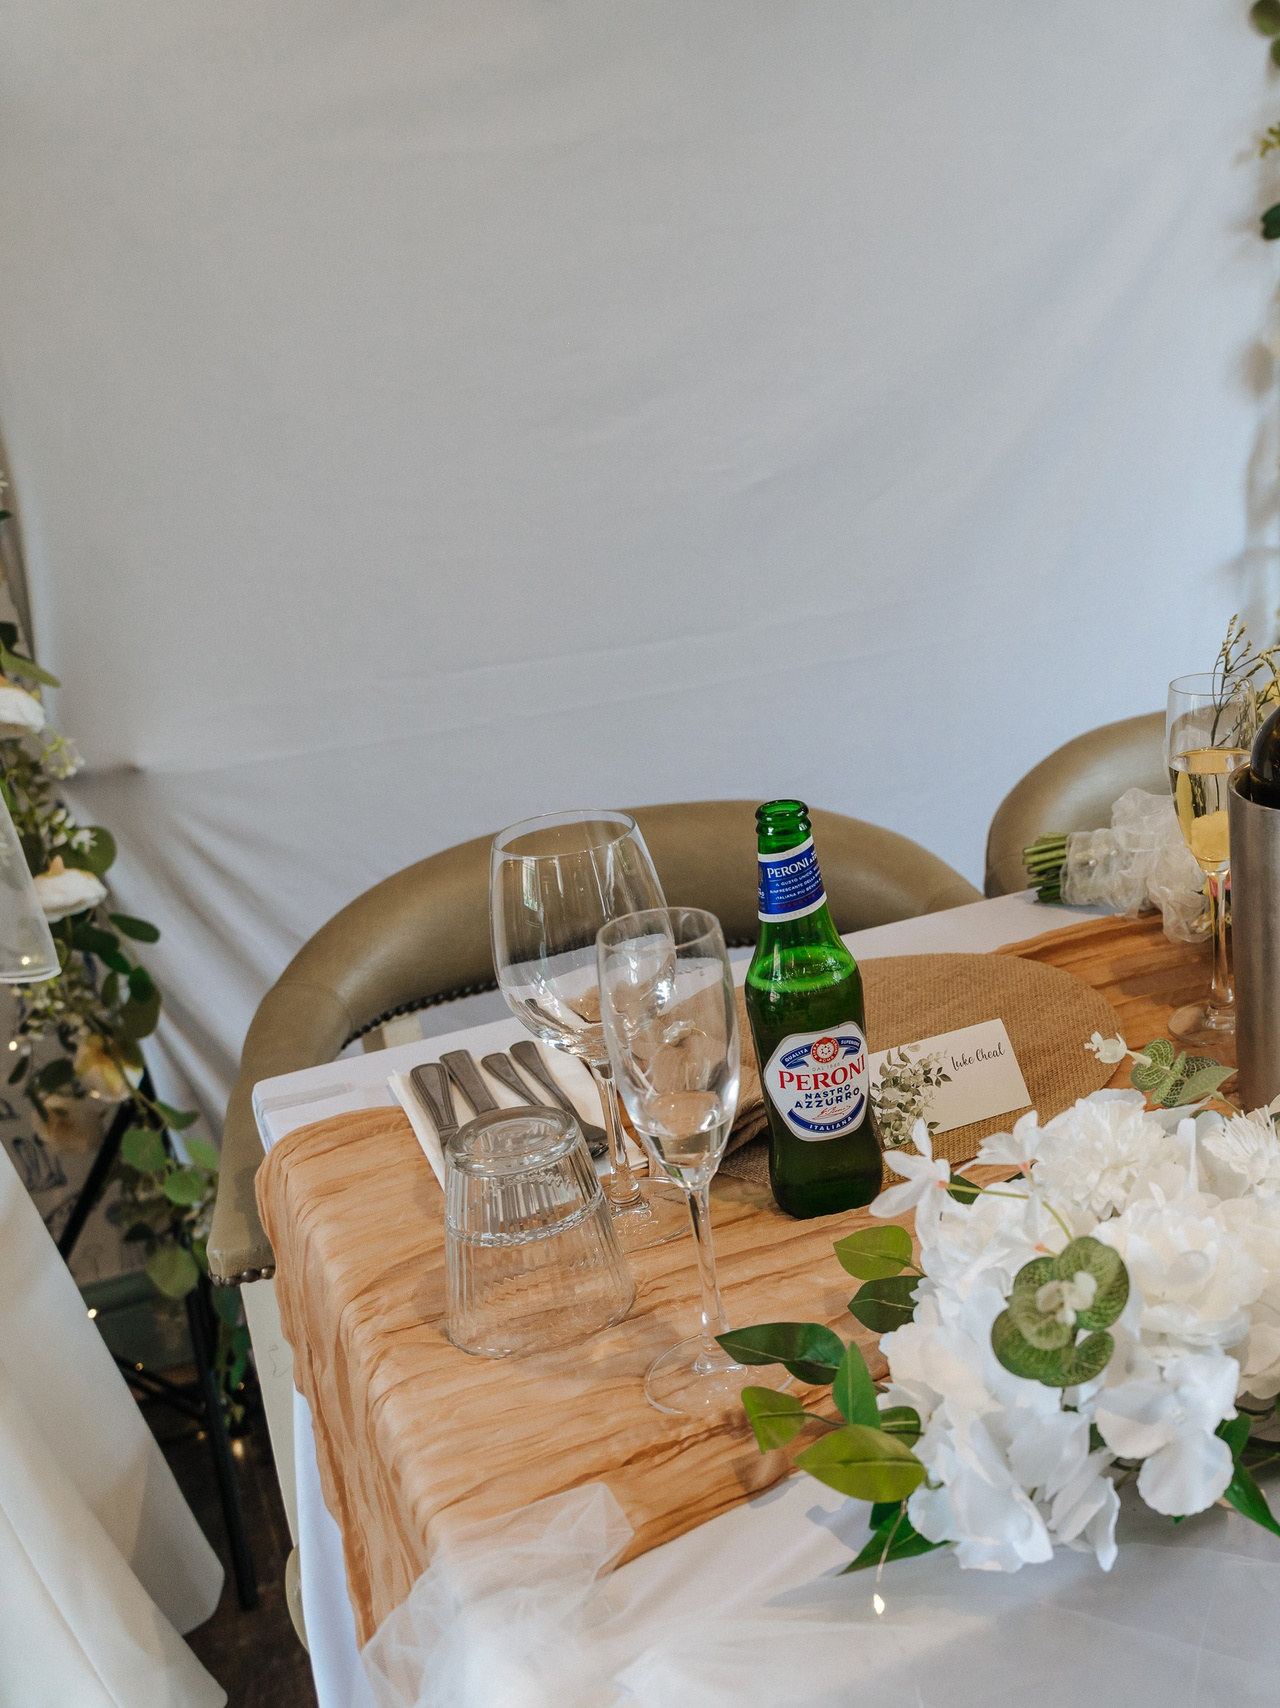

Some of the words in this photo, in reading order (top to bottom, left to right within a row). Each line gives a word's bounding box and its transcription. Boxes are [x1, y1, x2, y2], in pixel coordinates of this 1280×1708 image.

[766, 857, 810, 879] PERONI
[951, 1052, 975, 1072] Luke
[975, 1041, 1006, 1062] Cheal
[778, 1054, 866, 1091] PERONI
[794, 1087, 860, 1109] AZZURRO
[804, 1083, 851, 1100] NASTRO
[809, 1116, 853, 1131] ITALIANA
